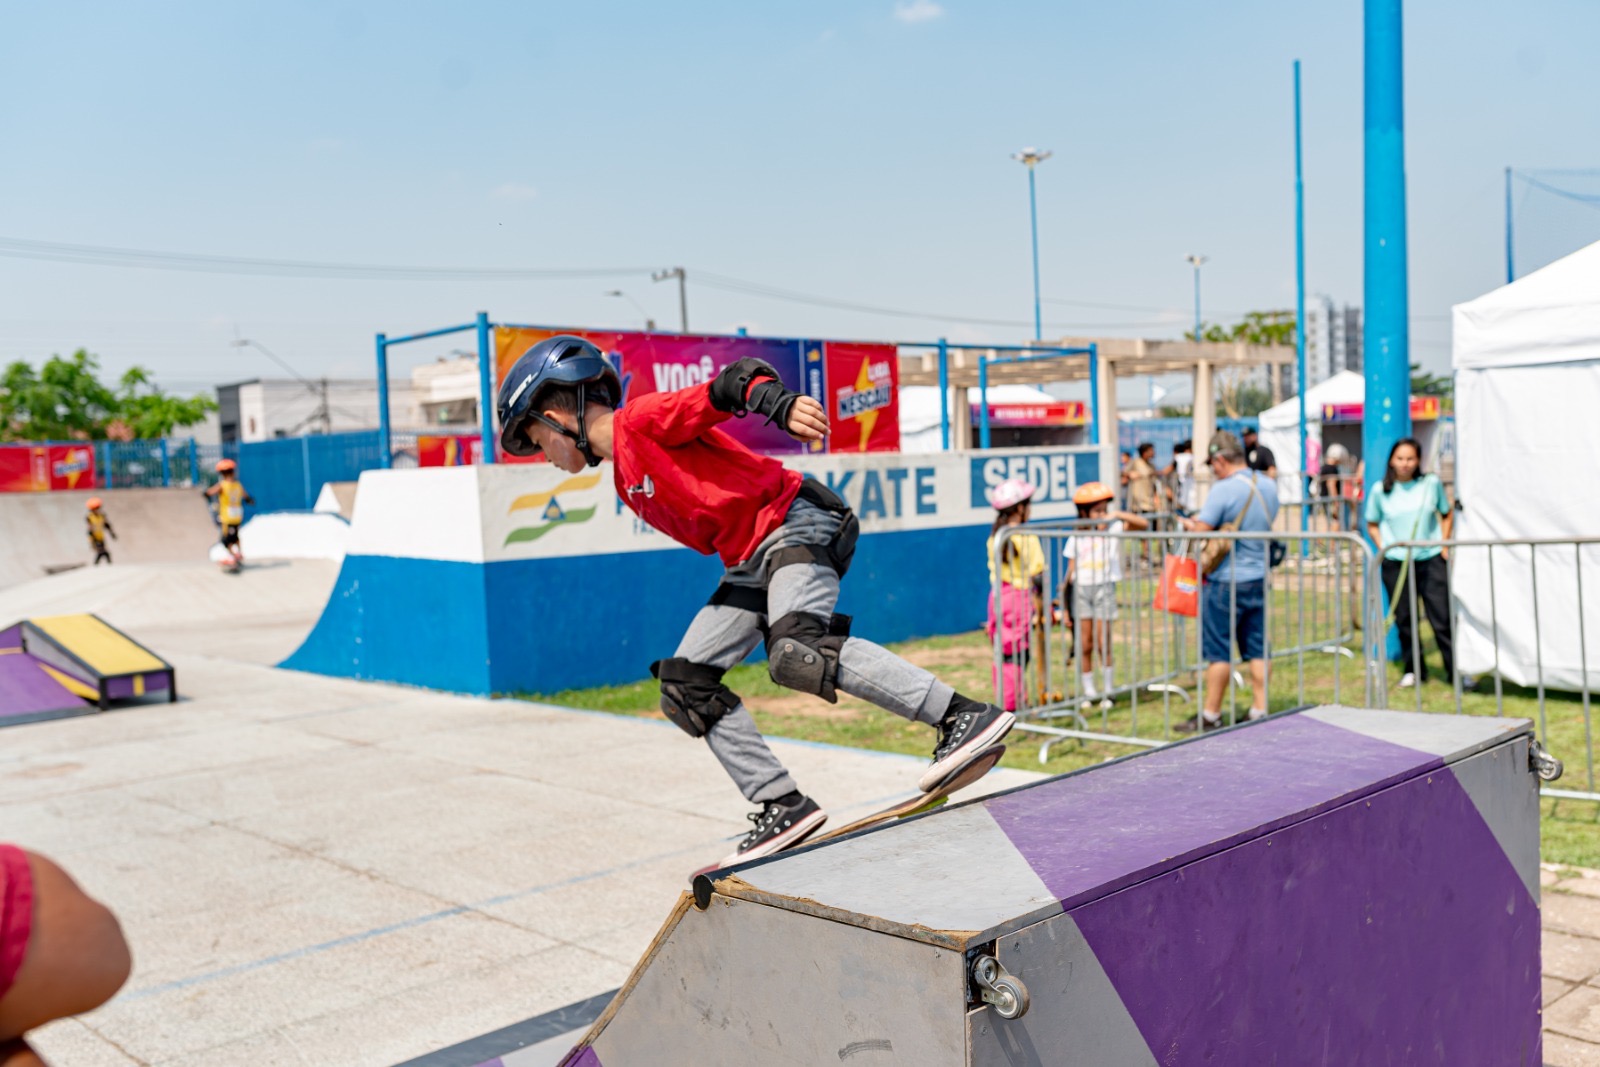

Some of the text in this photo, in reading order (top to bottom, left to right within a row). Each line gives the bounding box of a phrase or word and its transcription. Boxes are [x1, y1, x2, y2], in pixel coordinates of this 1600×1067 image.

[653, 355, 714, 393] VOCÊ
[838, 384, 891, 420] NESCAU
[802, 467, 937, 519] KATE
